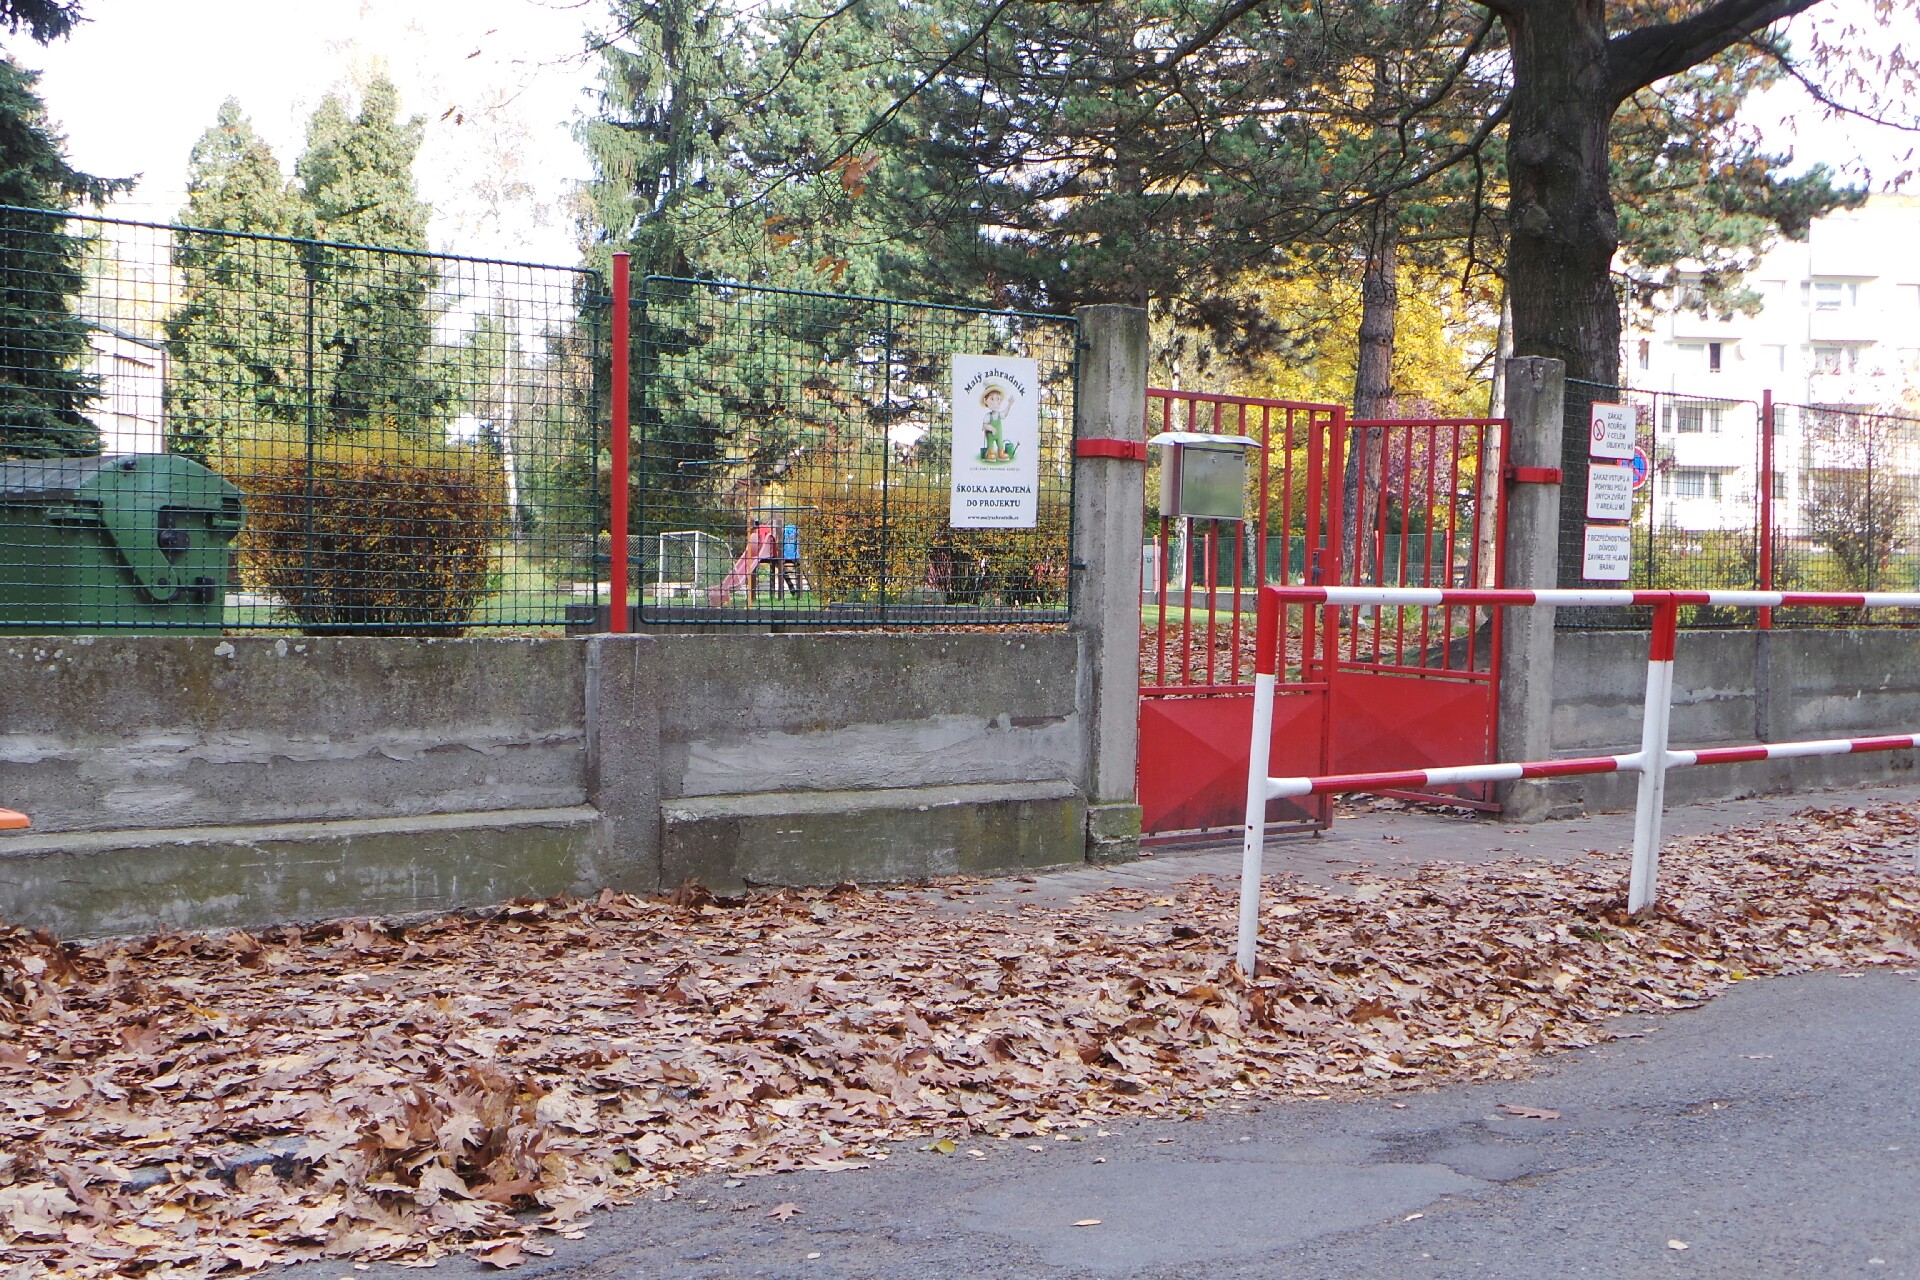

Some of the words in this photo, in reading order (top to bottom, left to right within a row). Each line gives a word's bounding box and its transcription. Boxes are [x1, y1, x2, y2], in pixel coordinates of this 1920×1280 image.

[964, 372, 982, 394] Malý
[985, 368, 1025, 397] zahradník
[1608, 412, 1623, 420] ZÁKAZ
[1608, 422, 1626, 430] KOUŘENÍ
[956, 484, 988, 492] ŠKOLKA
[990, 484, 1031, 494] ZAPOJENÁ
[1611, 492, 1626, 500] ZVÍŘAT
[1591, 534, 1630, 542] BEZPEČNOSTNÍCH
